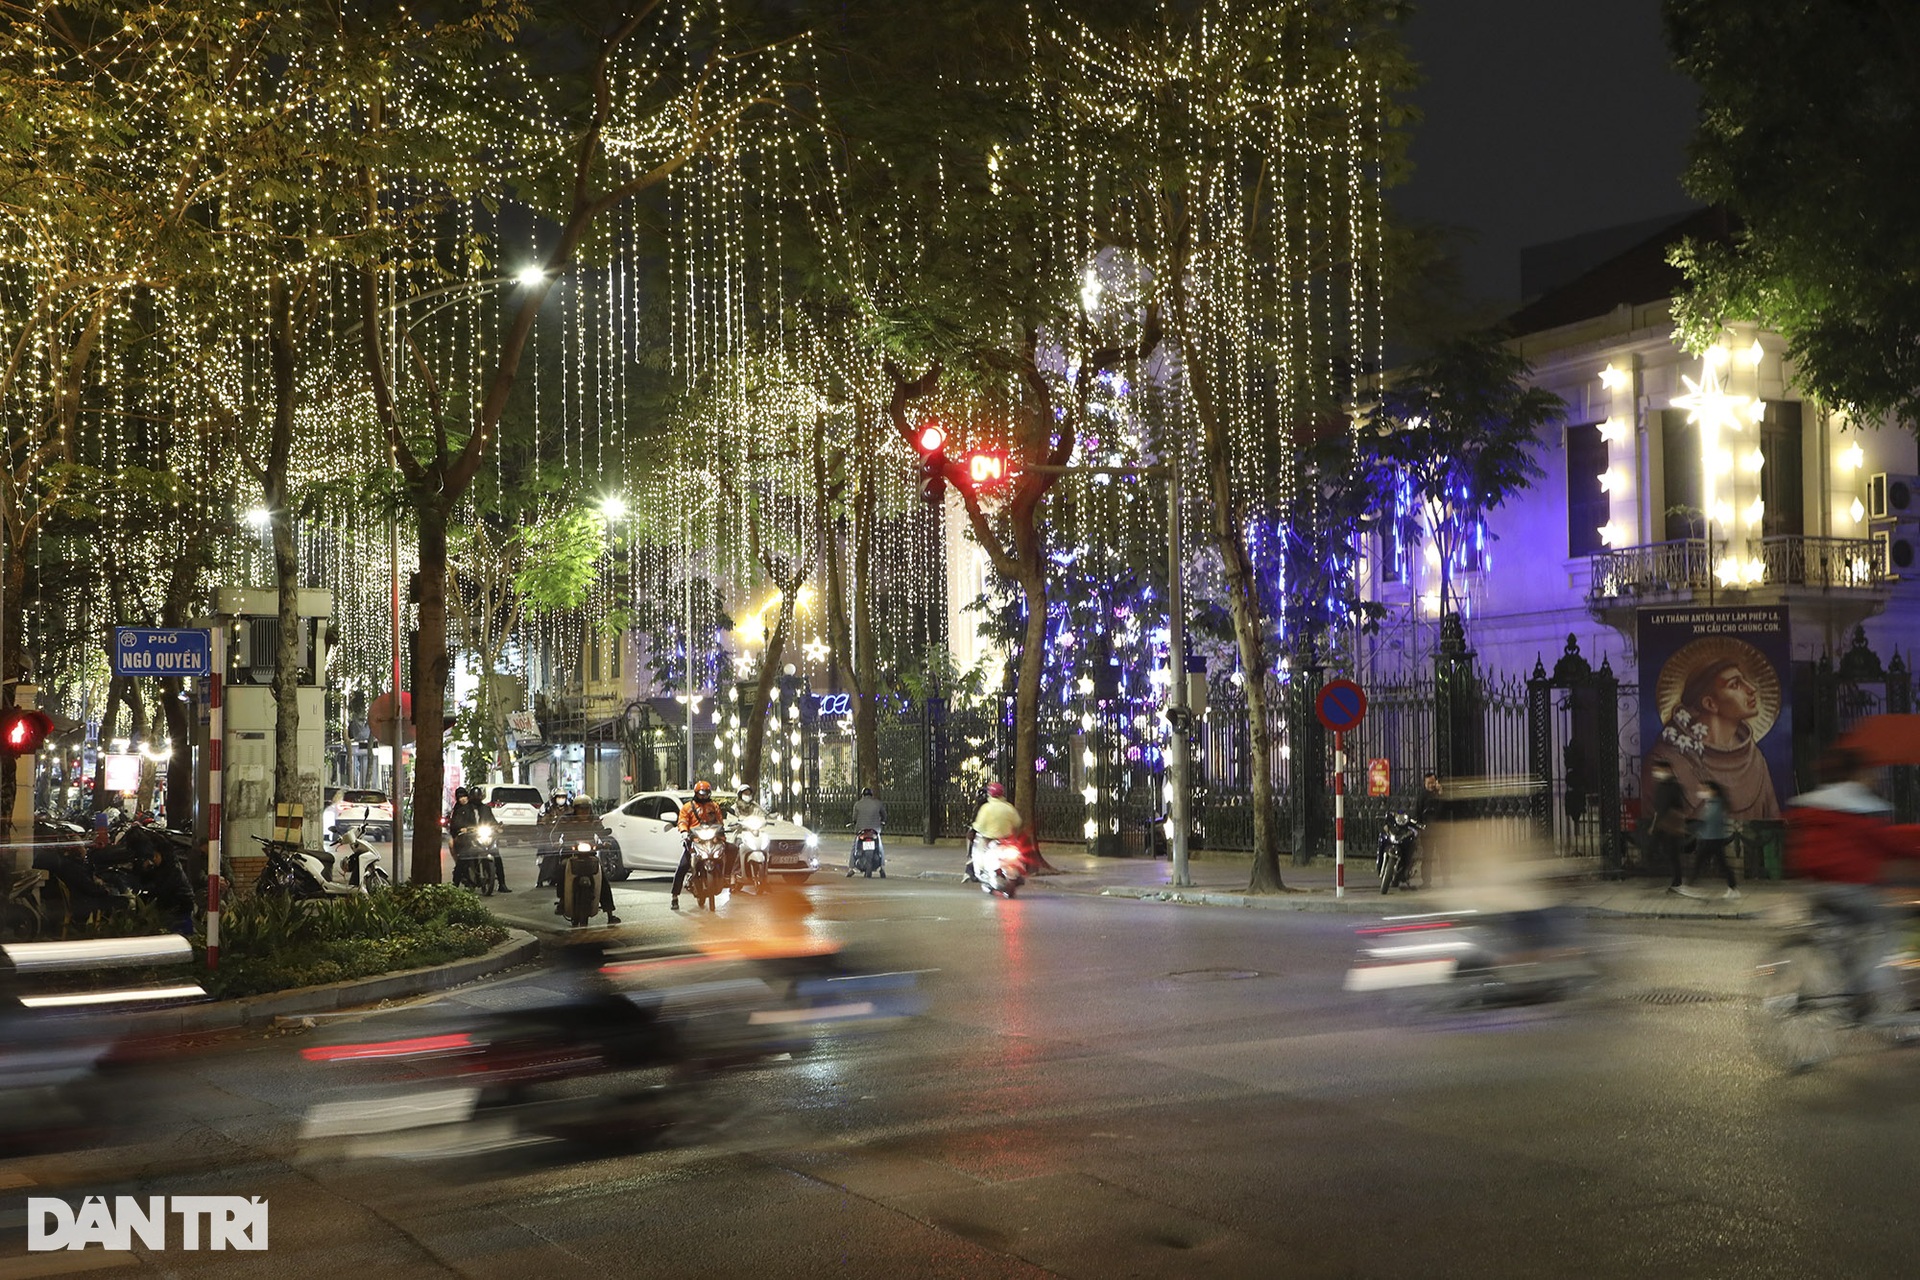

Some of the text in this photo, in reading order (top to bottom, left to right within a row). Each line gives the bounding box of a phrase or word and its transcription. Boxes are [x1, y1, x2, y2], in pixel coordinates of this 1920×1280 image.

[1666, 613, 1690, 623] THÁNH
[1692, 612, 1715, 623] ANTÔN
[1749, 610, 1767, 620] PHÉP
[1693, 624, 1705, 633] XIN
[1722, 623, 1737, 632] CHO
[1738, 622, 1762, 632] CHÚNG
[148, 632, 177, 644] PHỐ
[122, 649, 201, 670] NGÔ QUYỀN
